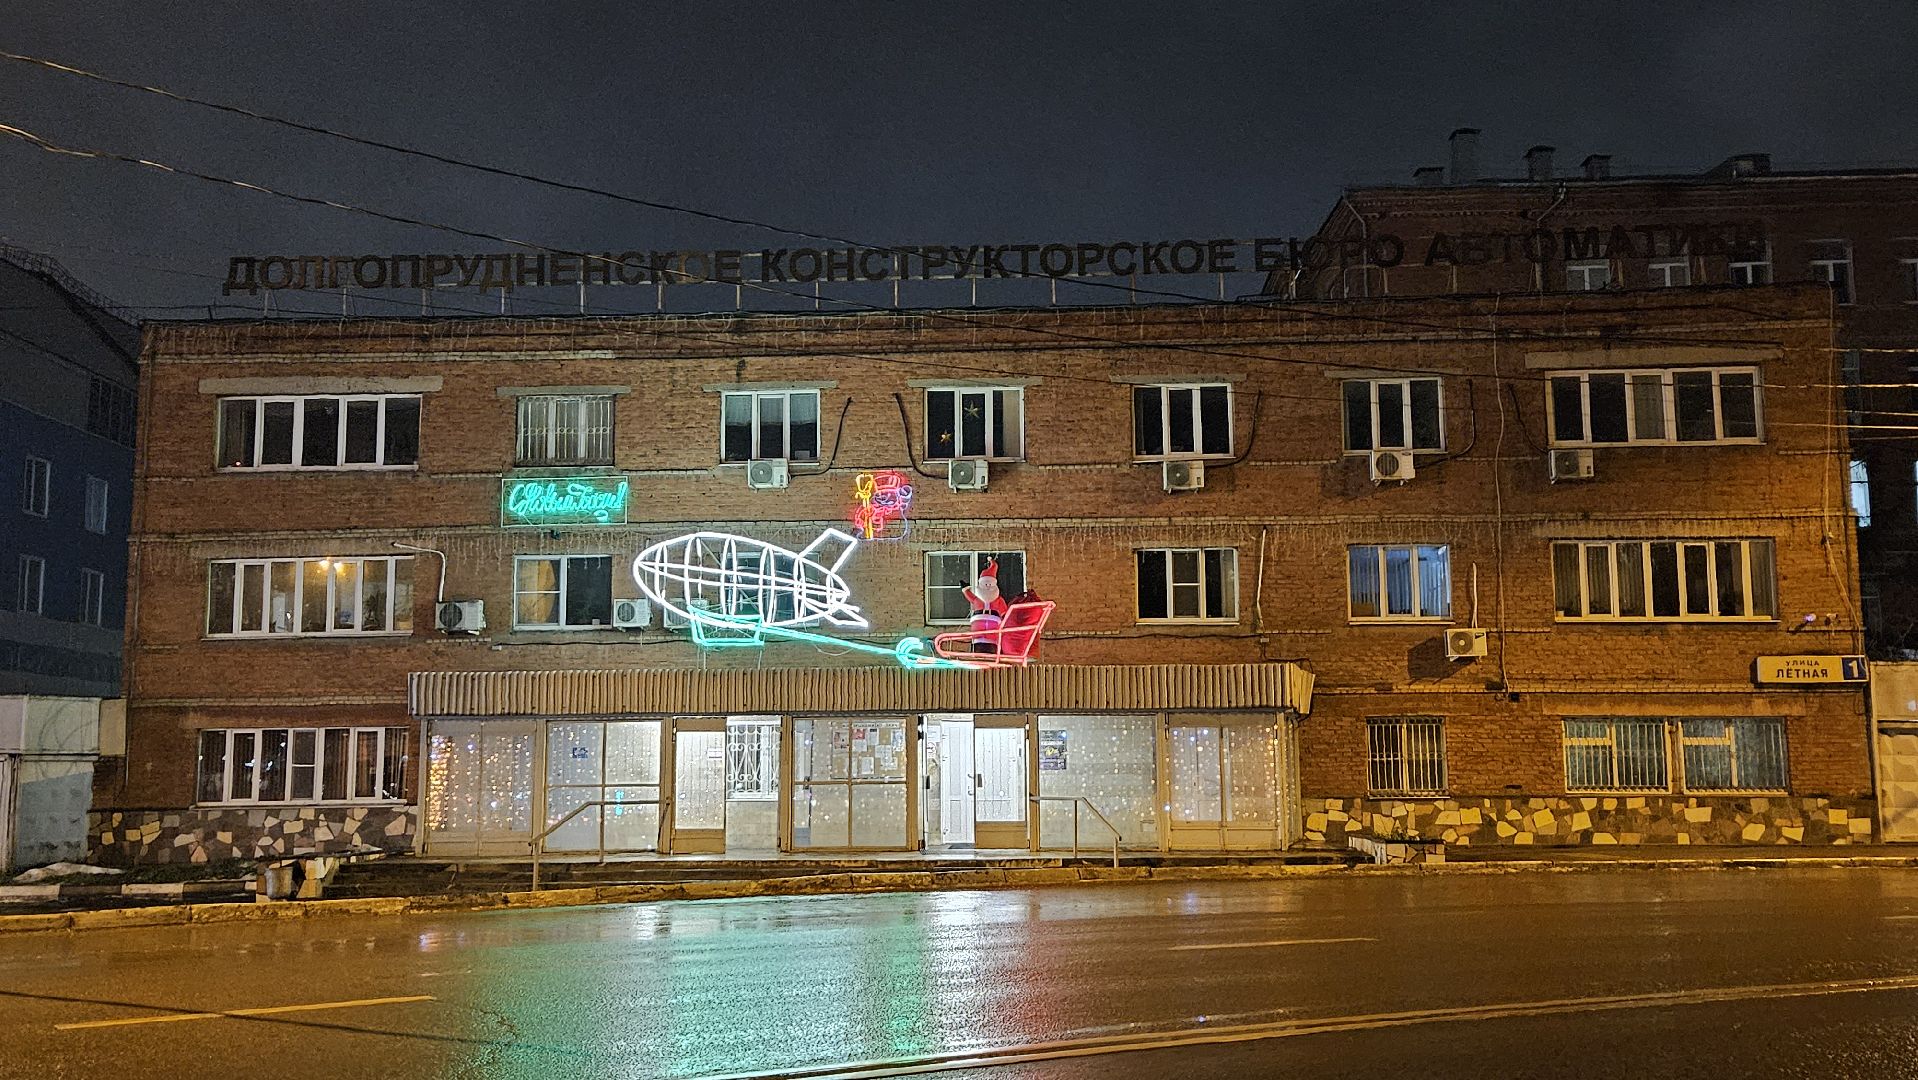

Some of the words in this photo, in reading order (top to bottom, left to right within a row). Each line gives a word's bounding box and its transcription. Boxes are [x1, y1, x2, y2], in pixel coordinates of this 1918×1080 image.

[222, 250, 743, 296] ДОЛГОПРУДНЕНСКОЕ
[760, 238, 1236, 283] КОНСТРУКТОРСКОЕ
[1255, 233, 1404, 271] БЮРО
[1848, 660, 1859, 678] 1
